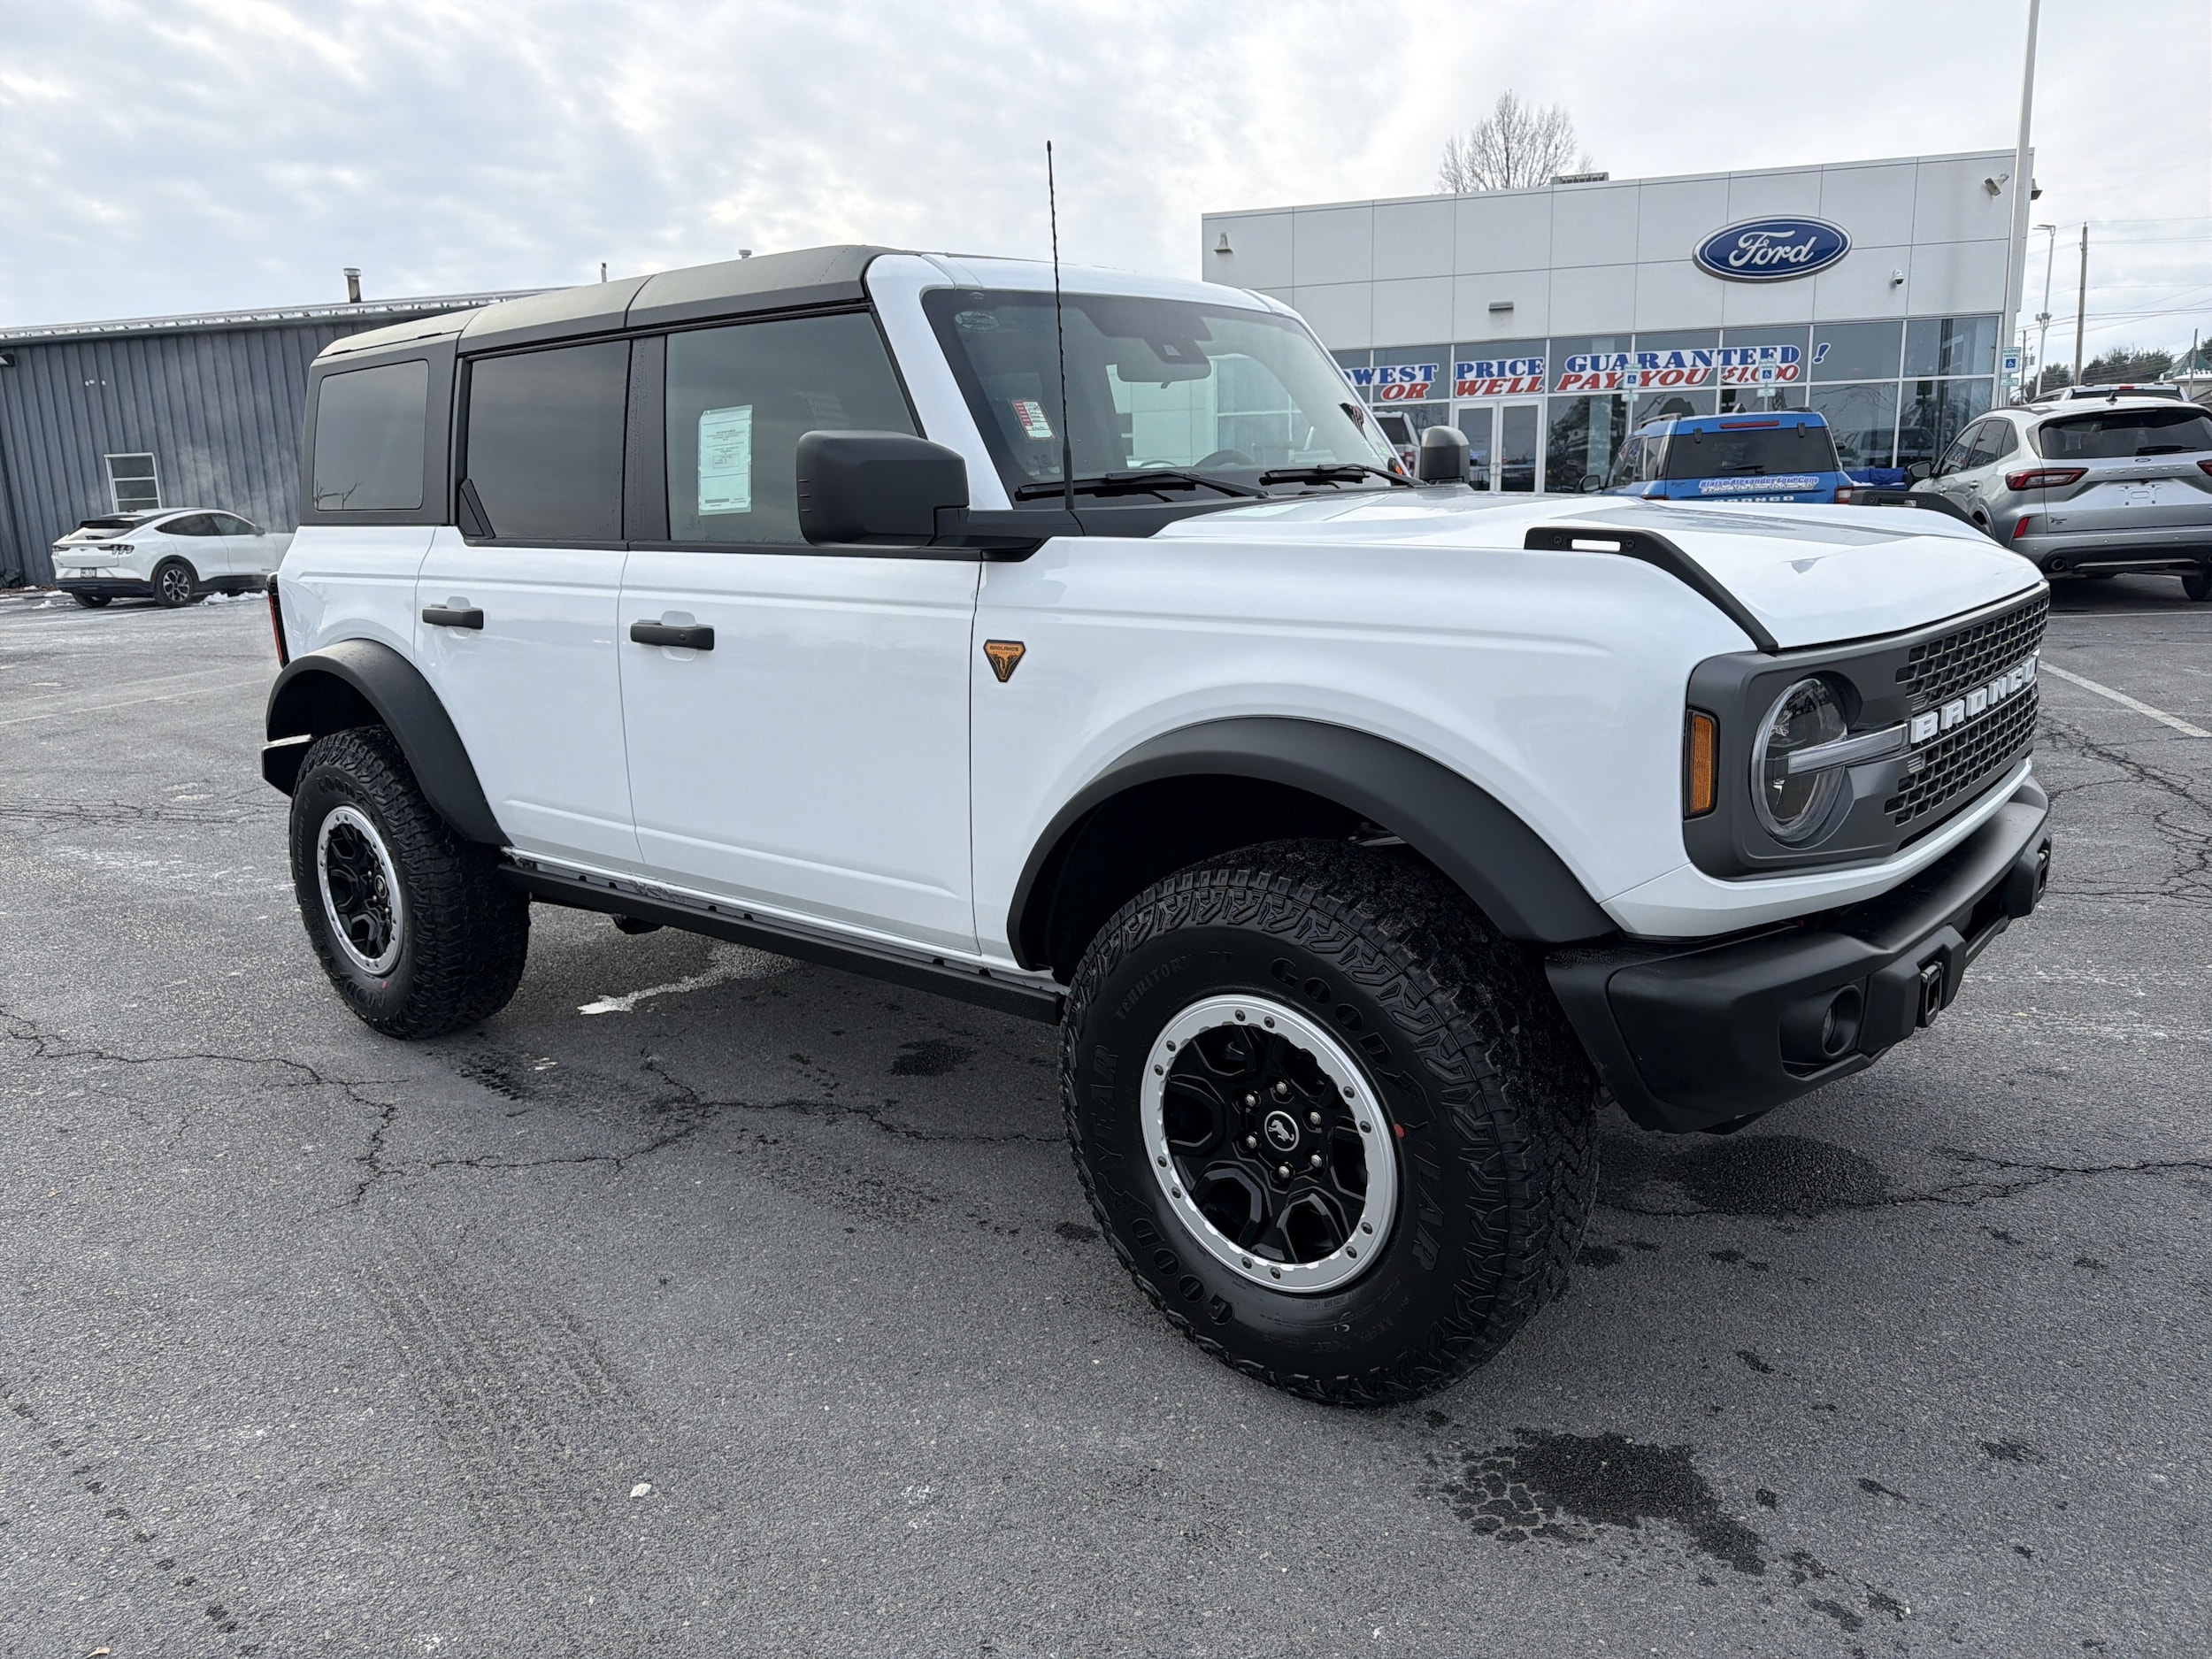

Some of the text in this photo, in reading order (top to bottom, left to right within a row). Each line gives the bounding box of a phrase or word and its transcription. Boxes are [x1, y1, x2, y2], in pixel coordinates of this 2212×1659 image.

[1728, 230, 1817, 267] Ford
[1455, 358, 1544, 380] PRICE
[1566, 347, 1800, 373] GUARANTEED
[1382, 383, 1429, 400] OR
[1456, 376, 1544, 396] WE'LL
[1556, 371, 1624, 391] PAY
[1640, 368, 1711, 387] YOU
[1910, 656, 2036, 744] BRONCO
